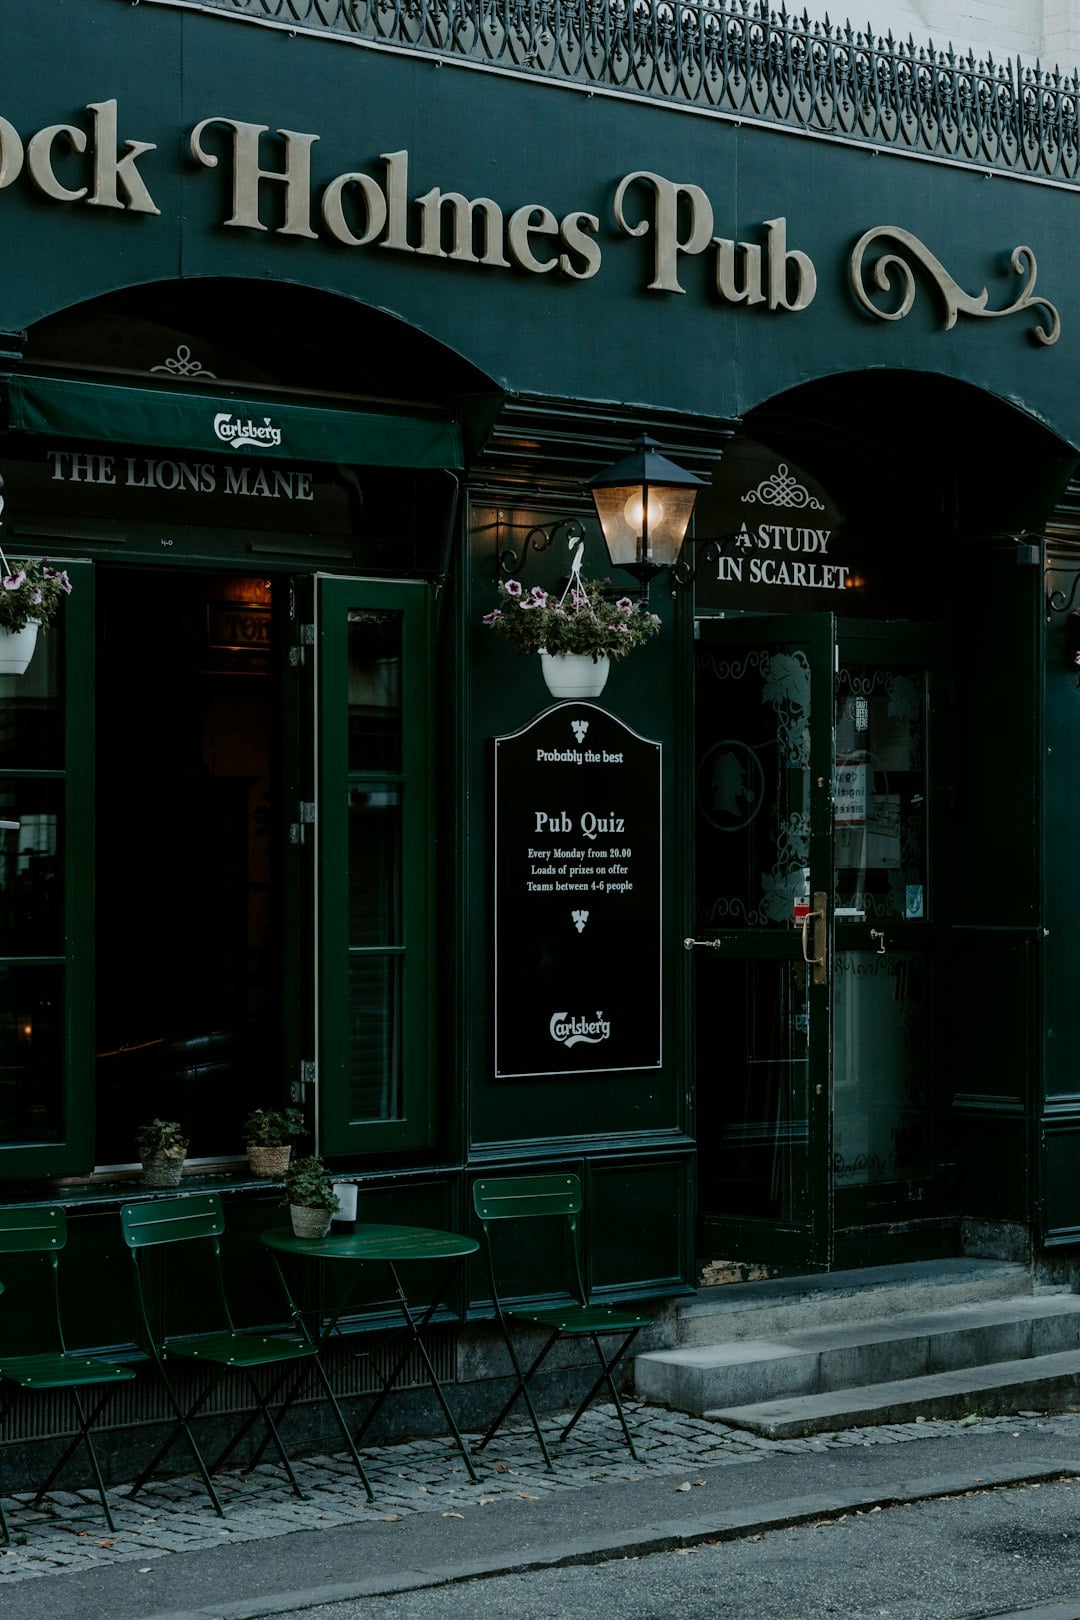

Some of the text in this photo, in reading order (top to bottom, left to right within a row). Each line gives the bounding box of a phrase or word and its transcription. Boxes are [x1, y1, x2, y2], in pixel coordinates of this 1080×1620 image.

[190, 116, 601, 280] Holmes
[613, 171, 817, 312] Pub
[213, 413, 282, 448] Carlsberg
[48, 450, 314, 501] THE LIONS MANE
[735, 522, 832, 554] A STUDY
[717, 556, 850, 590] IN SCARLET
[536, 749, 624, 765] Probably the best
[535, 812, 625, 840] Pub Quiz
[527, 848, 632, 861] Every Monday from 20.00
[527, 881, 634, 893] Teams between 4-6 people
[531, 864, 629, 878] Loads of prizes on offer
[549, 1010, 611, 1048] Carlsberg
